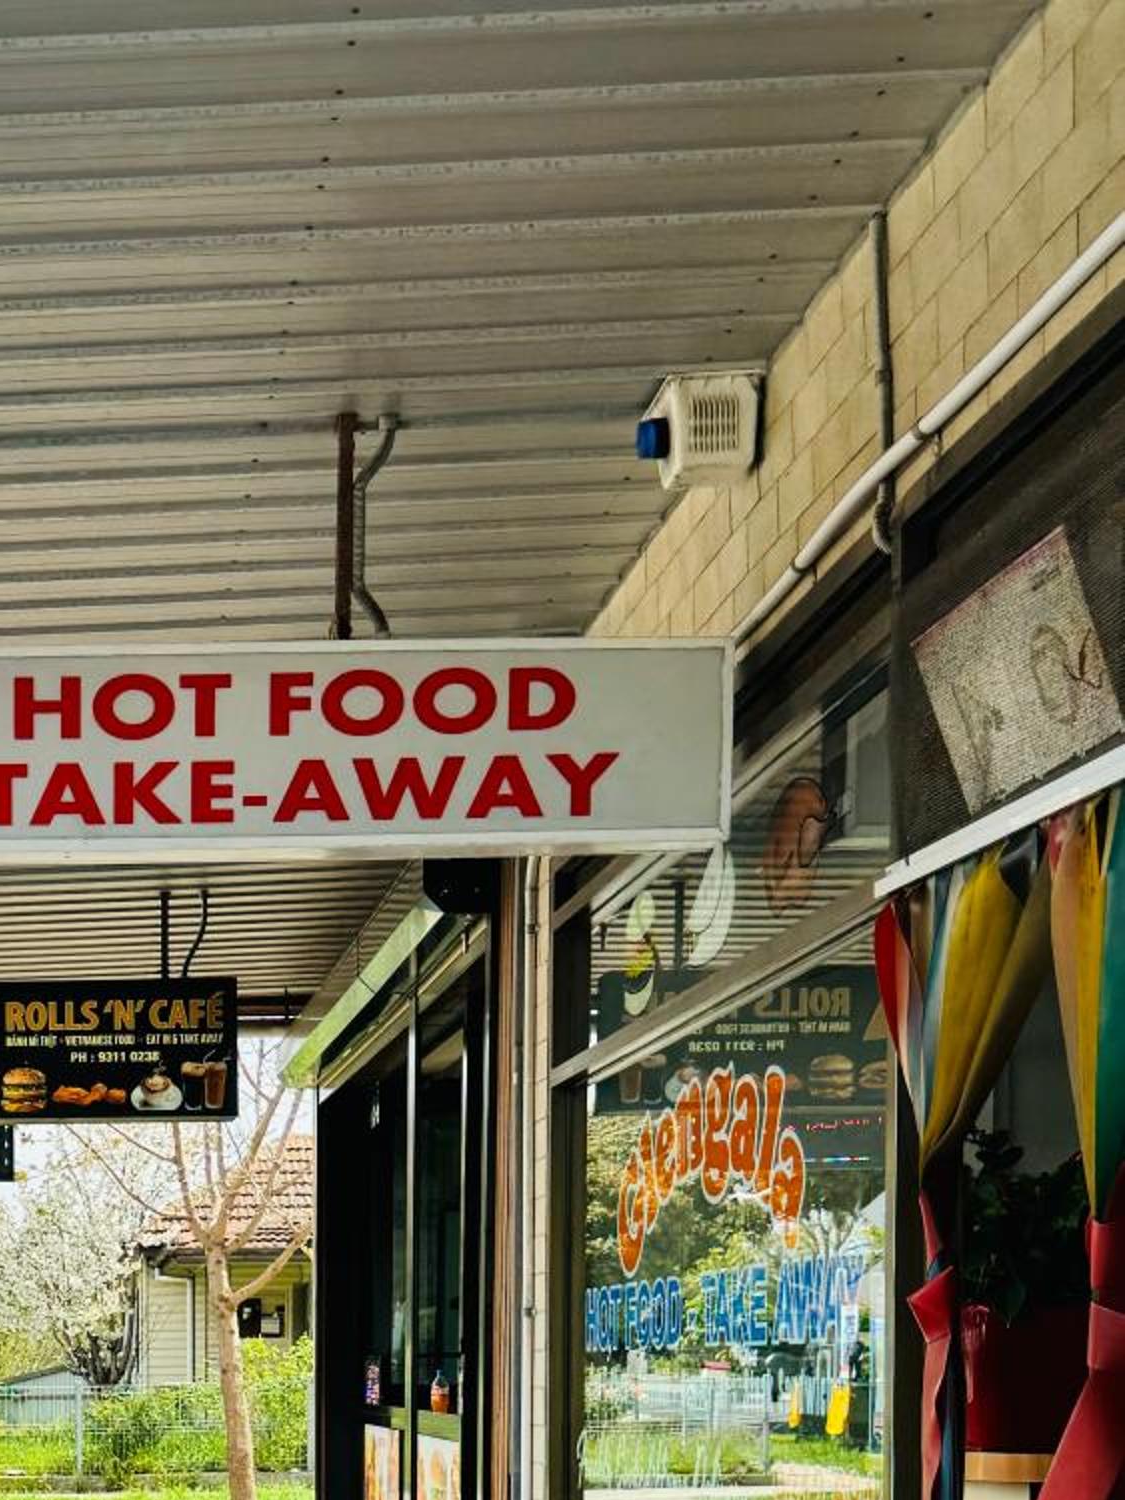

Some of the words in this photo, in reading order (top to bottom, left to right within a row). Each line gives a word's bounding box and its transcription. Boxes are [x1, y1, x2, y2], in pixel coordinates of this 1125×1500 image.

[13, 672, 232, 741] HOT
[268, 666, 577, 736] FOOD
[4, 1000, 100, 1032] ROLLS
[148, 991, 224, 1030] CAFÉ
[70, 1052, 88, 1063] PH
[98, 1051, 125, 1063] 9311
[618, 1063, 805, 1277] Glengala
[585, 1284, 623, 1353] HOT
[625, 1276, 683, 1351] FOOD
[701, 1263, 769, 1348] TAKE
[772, 1253, 866, 1346] AWAY
